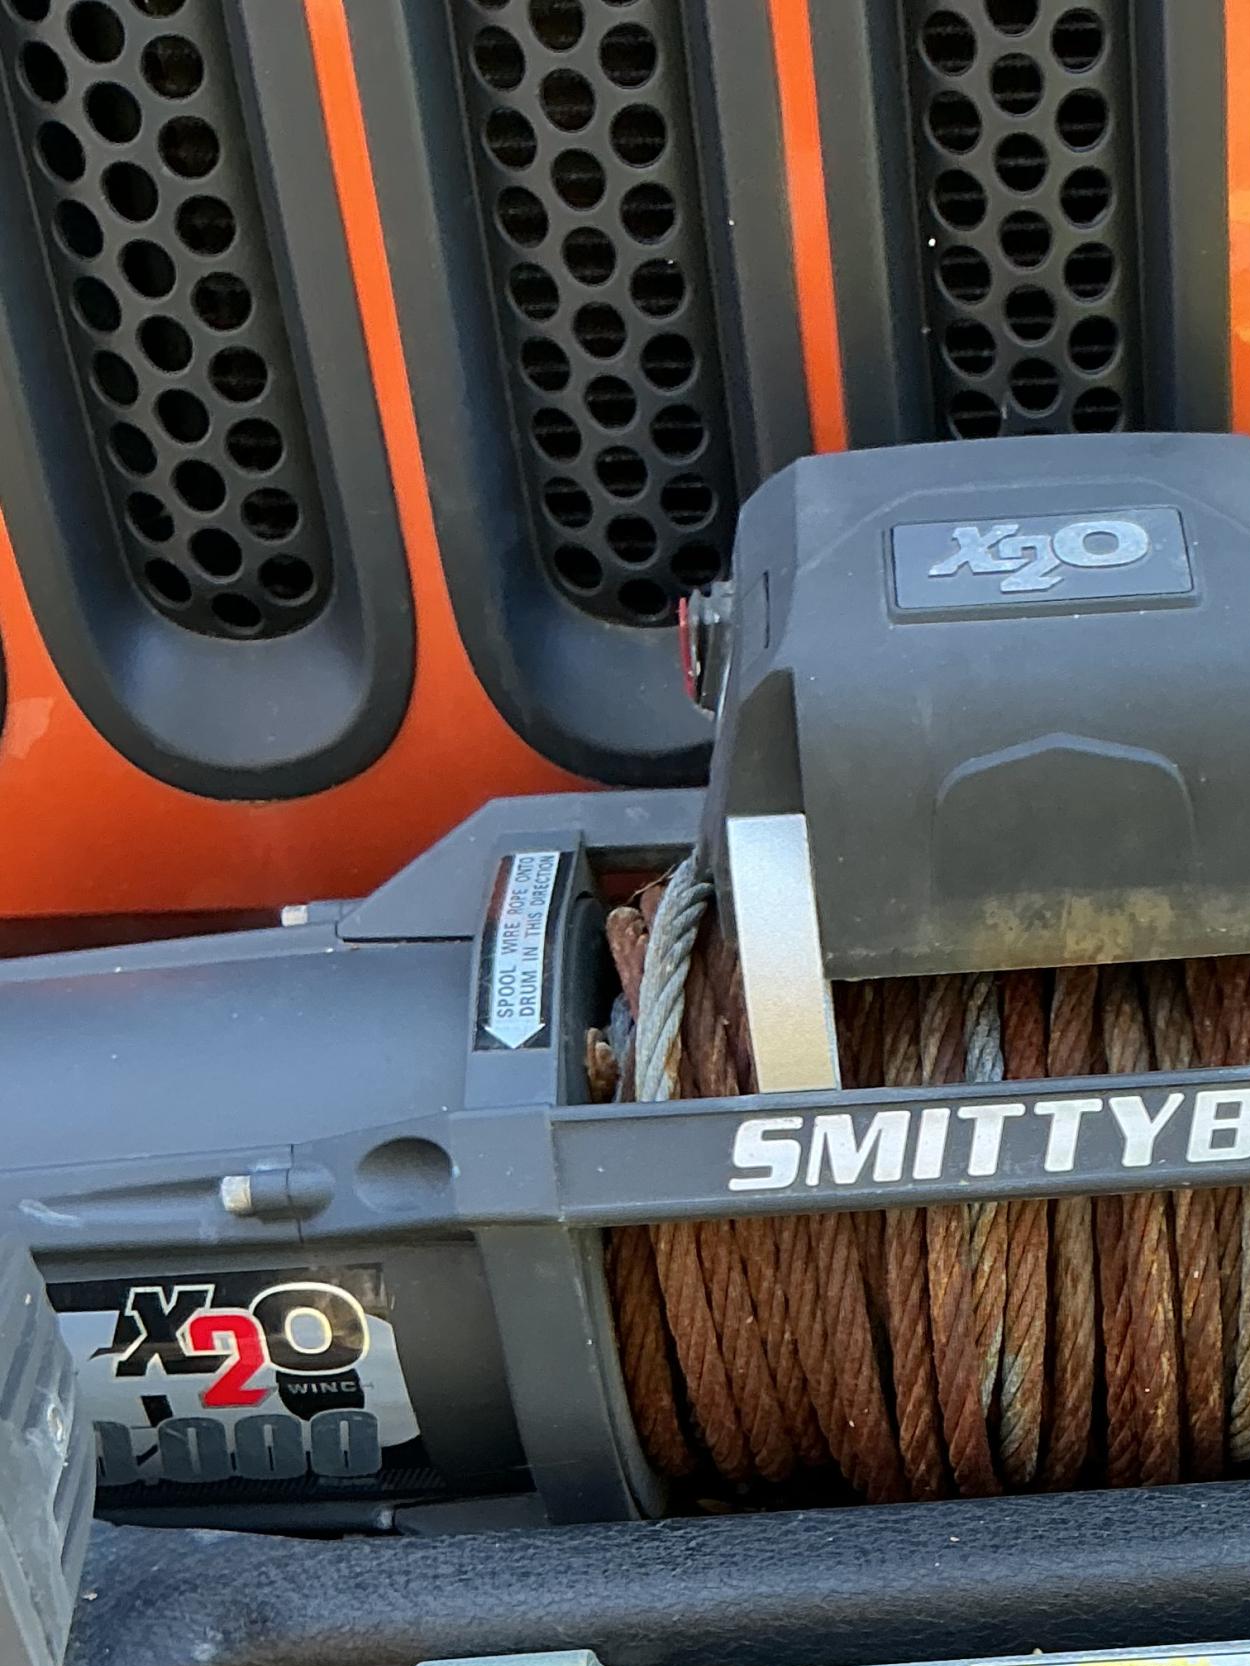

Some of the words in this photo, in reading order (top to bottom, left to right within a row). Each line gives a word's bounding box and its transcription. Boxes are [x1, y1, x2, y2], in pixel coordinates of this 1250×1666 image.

[515, 856, 534, 883] ONTO
[530, 855, 555, 905] DIRECTION
[508, 888, 527, 915] ROPE
[501, 921, 521, 955] WIRE
[525, 912, 543, 939] THIS
[523, 945, 539, 961] IN
[497, 964, 516, 1018] SPOOL
[519, 971, 538, 1017] DRUM
[287, 1380, 374, 1395] WINC
